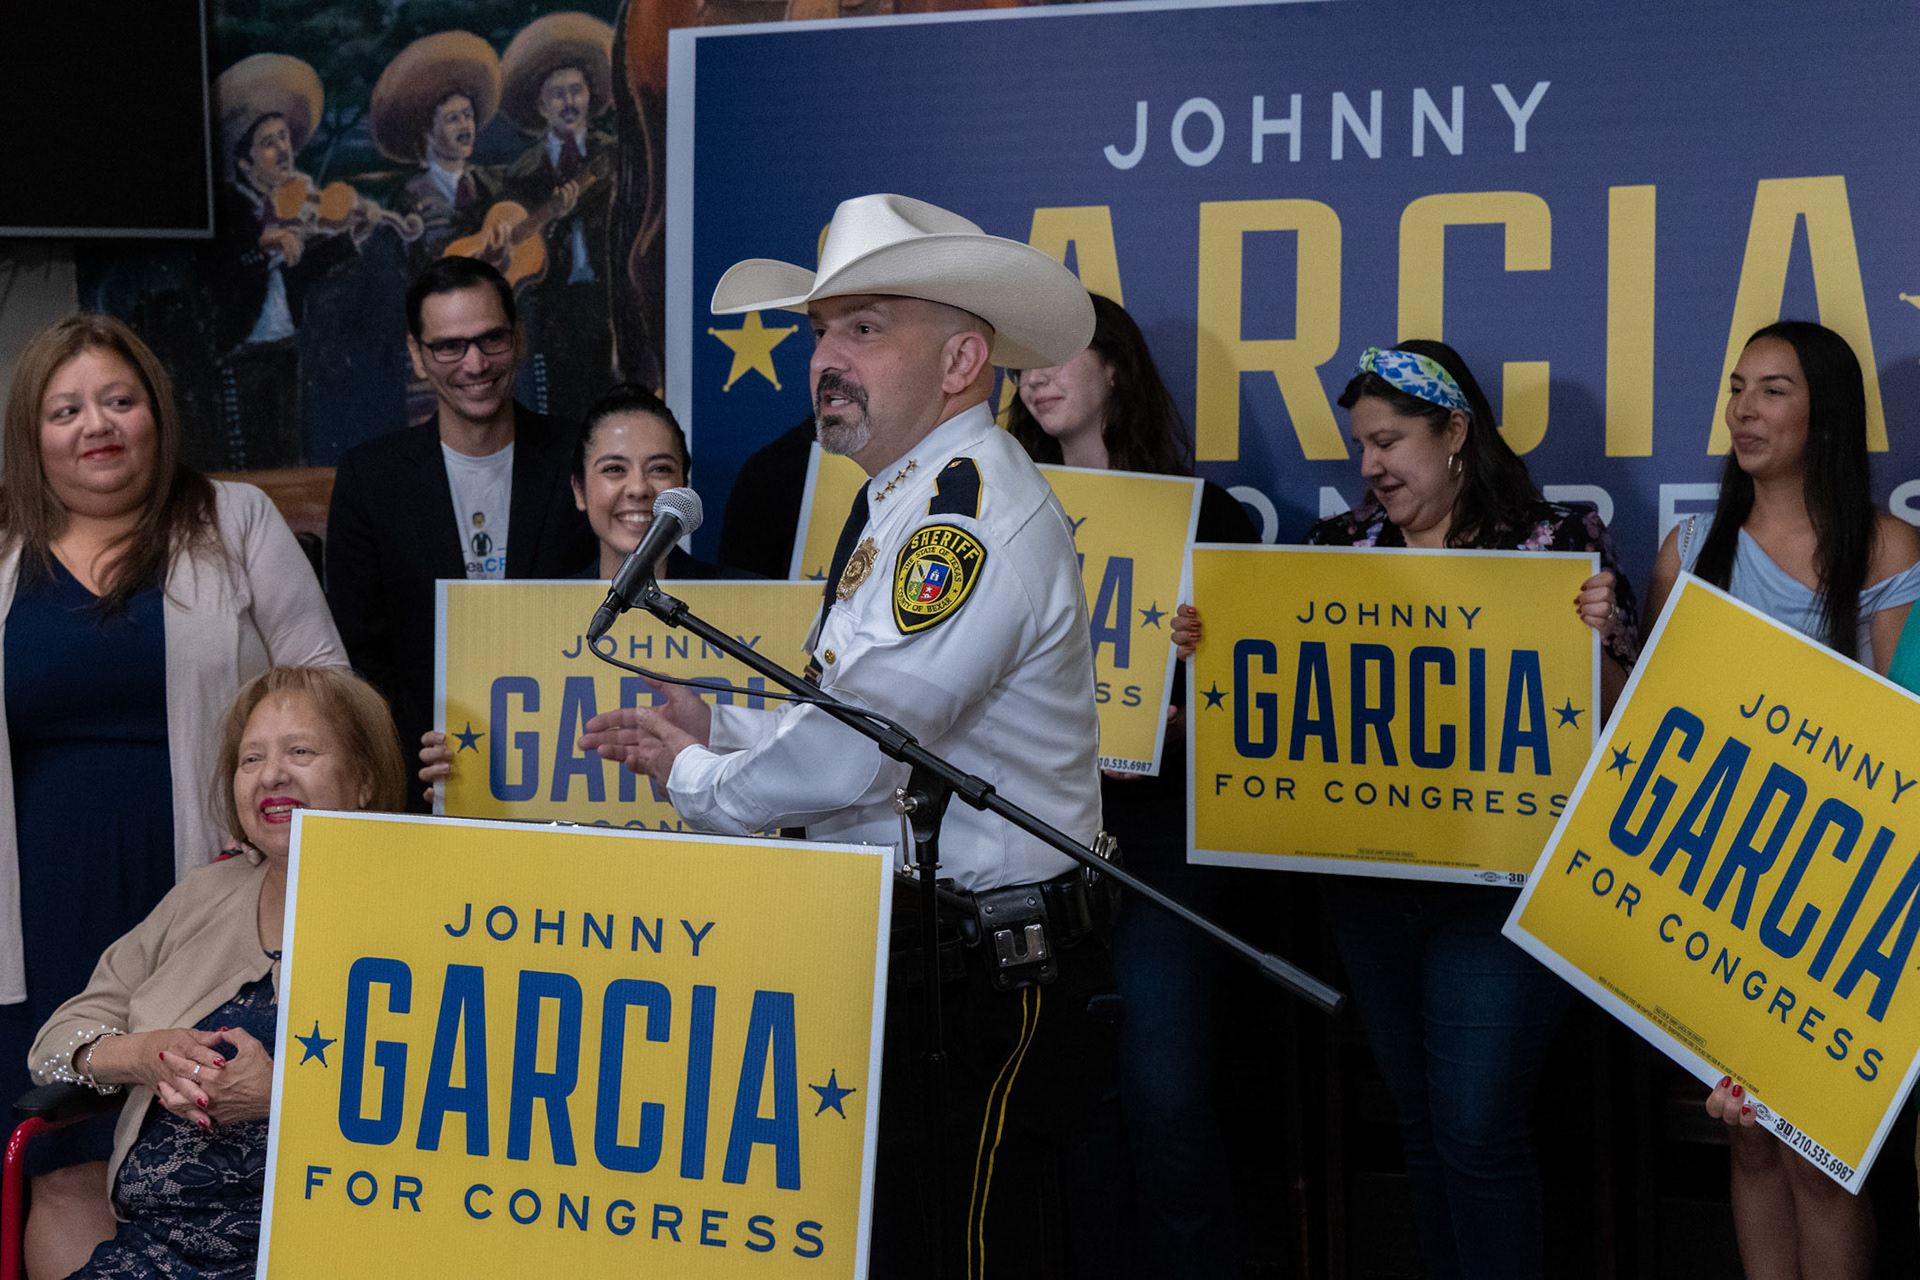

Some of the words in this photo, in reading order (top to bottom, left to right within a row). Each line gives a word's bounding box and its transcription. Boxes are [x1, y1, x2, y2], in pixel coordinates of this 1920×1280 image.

[1103, 81, 1551, 170] JOHNNY
[903, 557, 913, 571] THE
[915, 546, 937, 558] STATE
[938, 547, 950, 557] OF
[950, 557, 962, 582] TEXAS
[911, 531, 980, 560] SHERIFF
[926, 597, 952, 612] BEXAR
[1297, 601, 1481, 630] JOHNNY
[1233, 638, 1552, 776] GARCIA
[1098, 757, 1153, 773] 10.535.6987
[1740, 693, 1918, 805] JOHNNY
[1216, 774, 1295, 800] FOR
[1324, 780, 1568, 818] CONGRESS
[1608, 706, 1920, 1024] GARCIA
[444, 903, 715, 956] JOHNNY
[1566, 848, 1642, 917] FOR
[1658, 913, 1884, 1082] CONGRESS
[338, 956, 801, 1191] GARCIA
[1792, 1131, 1855, 1183] 210.535.6987
[304, 1165, 423, 1212] FOR
[464, 1183, 824, 1259] CONGRESS
